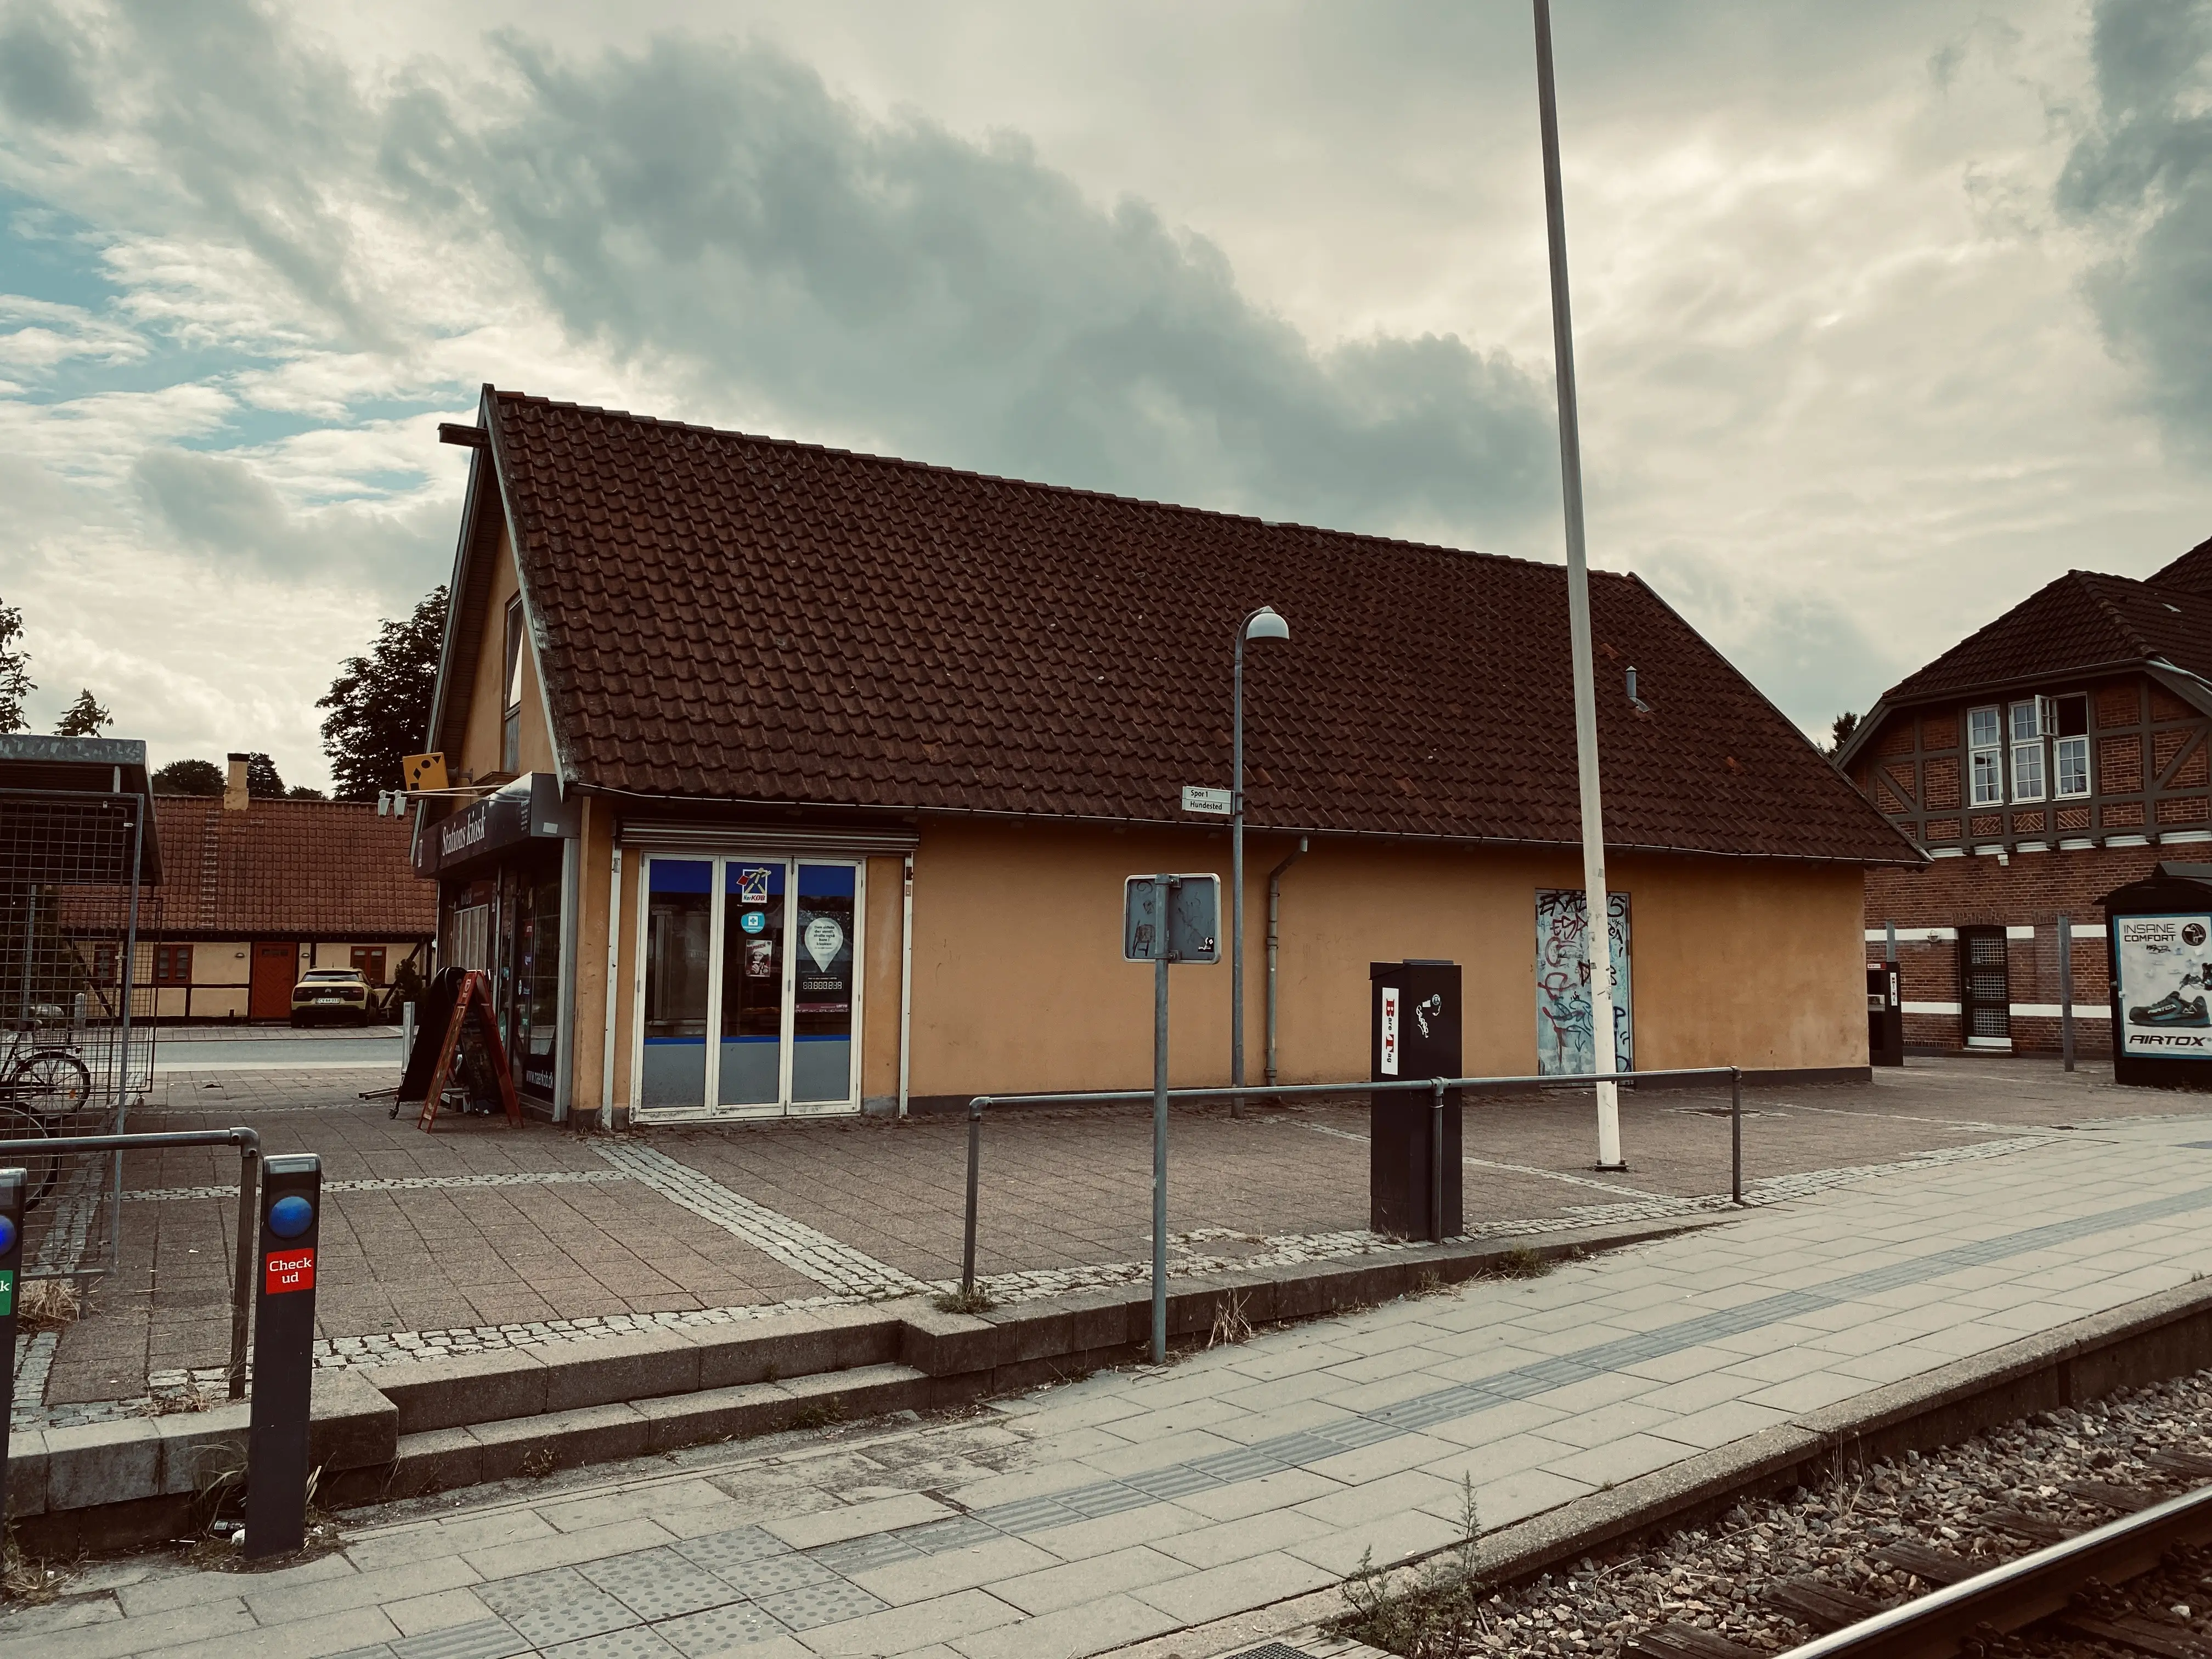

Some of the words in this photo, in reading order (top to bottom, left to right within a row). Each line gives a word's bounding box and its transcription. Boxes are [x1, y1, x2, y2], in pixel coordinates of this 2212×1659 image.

[1190, 789, 1204, 798] Spor
[1190, 801, 1222, 810] Hundested
[442, 821, 466, 856] Stations
[466, 805, 486, 846] kiosk
[2124, 923, 2176, 934] INSANE
[2124, 934, 2176, 942] COMFORT
[2129, 1035, 2205, 1047] AIRTOX
[1385, 1034, 1394, 1063] Tag
[269, 1257, 312, 1272] Check
[281, 1271, 299, 1284] ud
